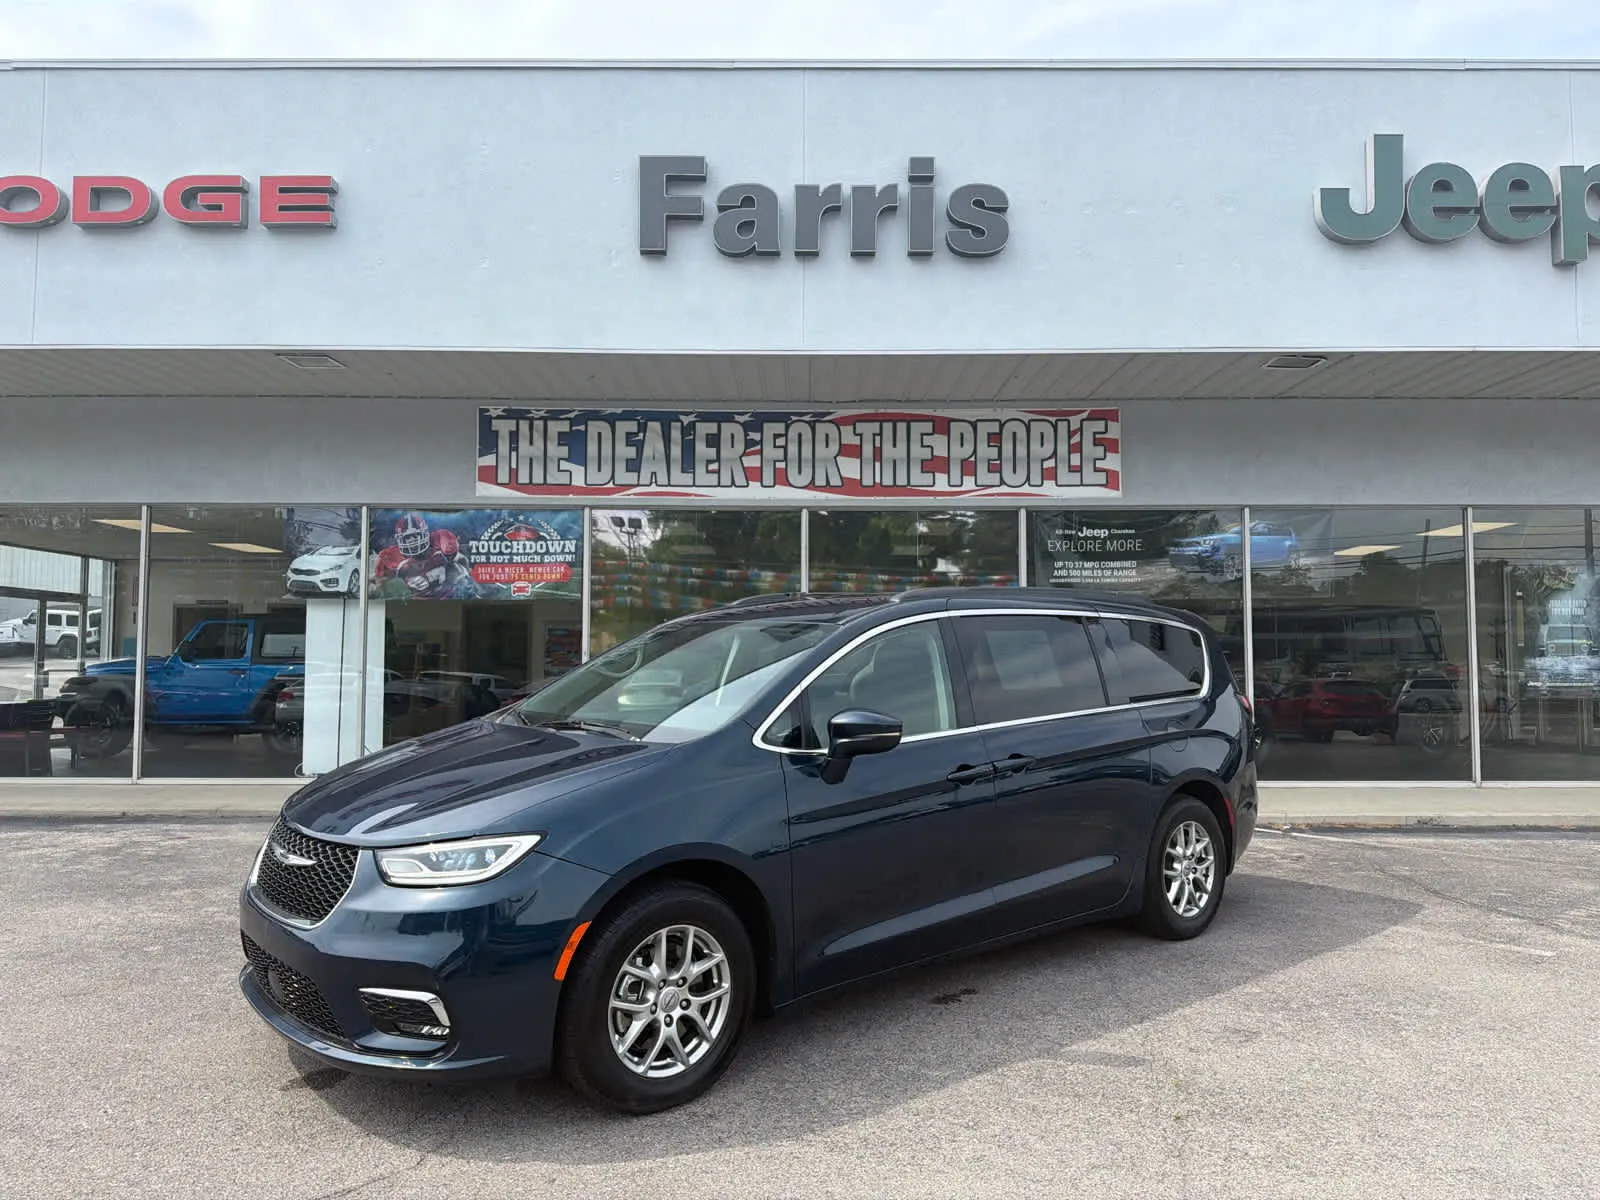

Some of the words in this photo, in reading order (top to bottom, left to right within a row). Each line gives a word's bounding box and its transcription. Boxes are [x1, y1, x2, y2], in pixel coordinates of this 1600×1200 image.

[638, 154, 1010, 257] Farris
[490, 417, 572, 486] THE
[584, 419, 749, 487] DEALER
[761, 419, 843, 488] FOR
[853, 419, 935, 487] THE
[947, 419, 1109, 488] PEOPLE
[1078, 526, 1109, 538] Jeep
[469, 540, 577, 553] TOUCHDOWN
[1047, 540, 1102, 552] EXPLORE
[470, 555, 487, 563] FOR
[490, 555, 510, 563] NOT
[513, 555, 540, 563] MUCH
[543, 554, 575, 562] DOWN!
[1101, 560, 1137, 568] COMBINED
[1053, 569, 1068, 577] AND
[1069, 569, 1080, 577] 500
[1082, 569, 1102, 577] MILES
[1103, 569, 1112, 577] OF
